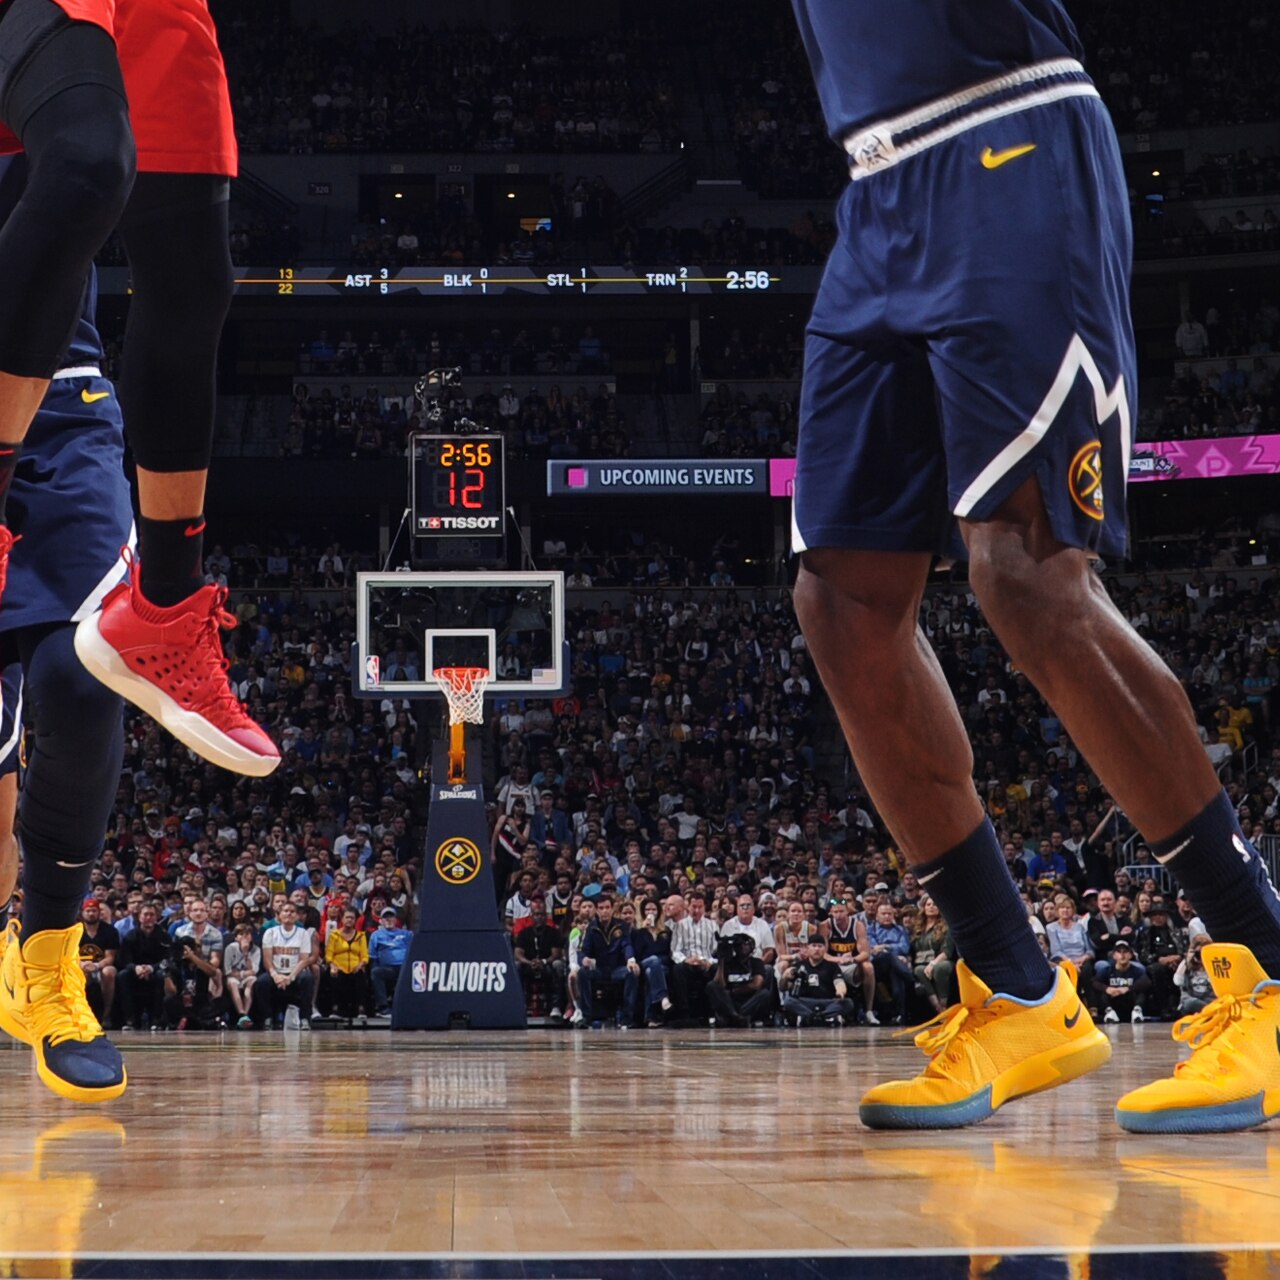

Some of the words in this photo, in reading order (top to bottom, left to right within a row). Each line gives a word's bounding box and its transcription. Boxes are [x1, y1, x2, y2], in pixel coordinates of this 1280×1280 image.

[279, 268, 293, 280] 13
[380, 268, 388, 279] 3
[480, 268, 488, 279] 0
[680, 267, 688, 278] 2
[345, 274, 372, 287] AST
[443, 274, 472, 287] BLK
[547, 274, 574, 287] STL
[645, 273, 676, 286] TRN
[726, 270, 769, 289] 2:56
[278, 283, 294, 295] 22
[380, 283, 388, 294] 5
[441, 443, 491, 467] 2:56
[600, 469, 689, 486] UPCOMING
[694, 468, 754, 485] EVENTS
[449, 470, 484, 509] 12
[441, 517, 499, 529] TISSOT
[439, 789, 477, 800] SPALDING
[428, 961, 507, 992] PLAYOFFS
